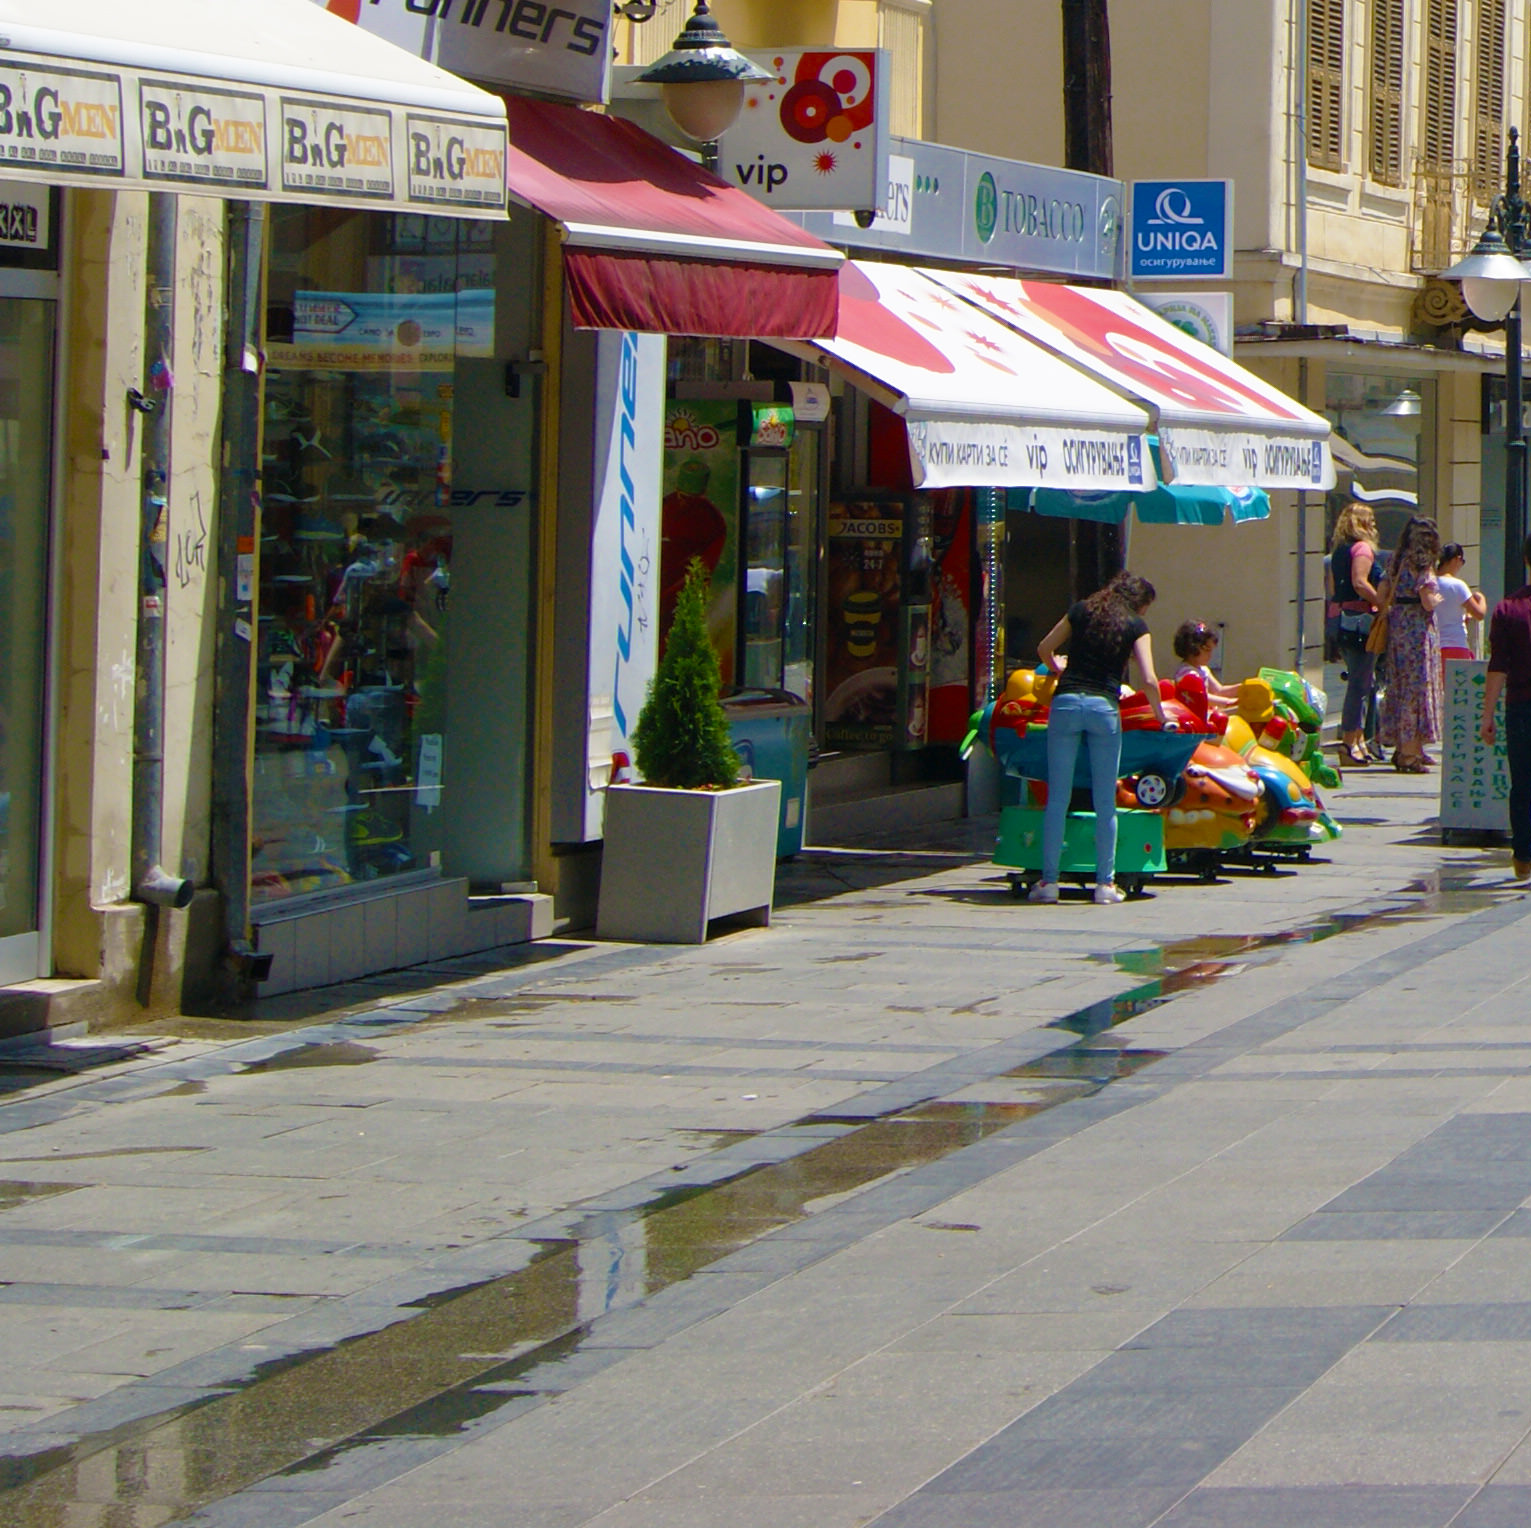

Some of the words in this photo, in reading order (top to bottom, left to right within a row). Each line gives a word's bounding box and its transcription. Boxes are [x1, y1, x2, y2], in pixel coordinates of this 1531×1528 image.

[60, 101, 118, 140] MEN
[212, 118, 263, 155] MEN
[344, 133, 389, 168] MEN
[463, 147, 503, 180] MEN
[735, 156, 789, 196] vip
[1002, 190, 1085, 243] TOBACCO
[1138, 231, 1218, 251] UNIQA
[1140, 256, 1216, 269] осигурување
[665, 423, 720, 451] ano
[928, 440, 954, 465] КУПИ
[955, 441, 984, 465] КАРТИ
[985, 443, 998, 467] ЗА
[1026, 434, 1047, 479] vip
[1063, 438, 1125, 477] ОСИГУРУВАЊЕ
[1241, 439, 1258, 478] vip
[839, 522, 895, 535] JACOBS
